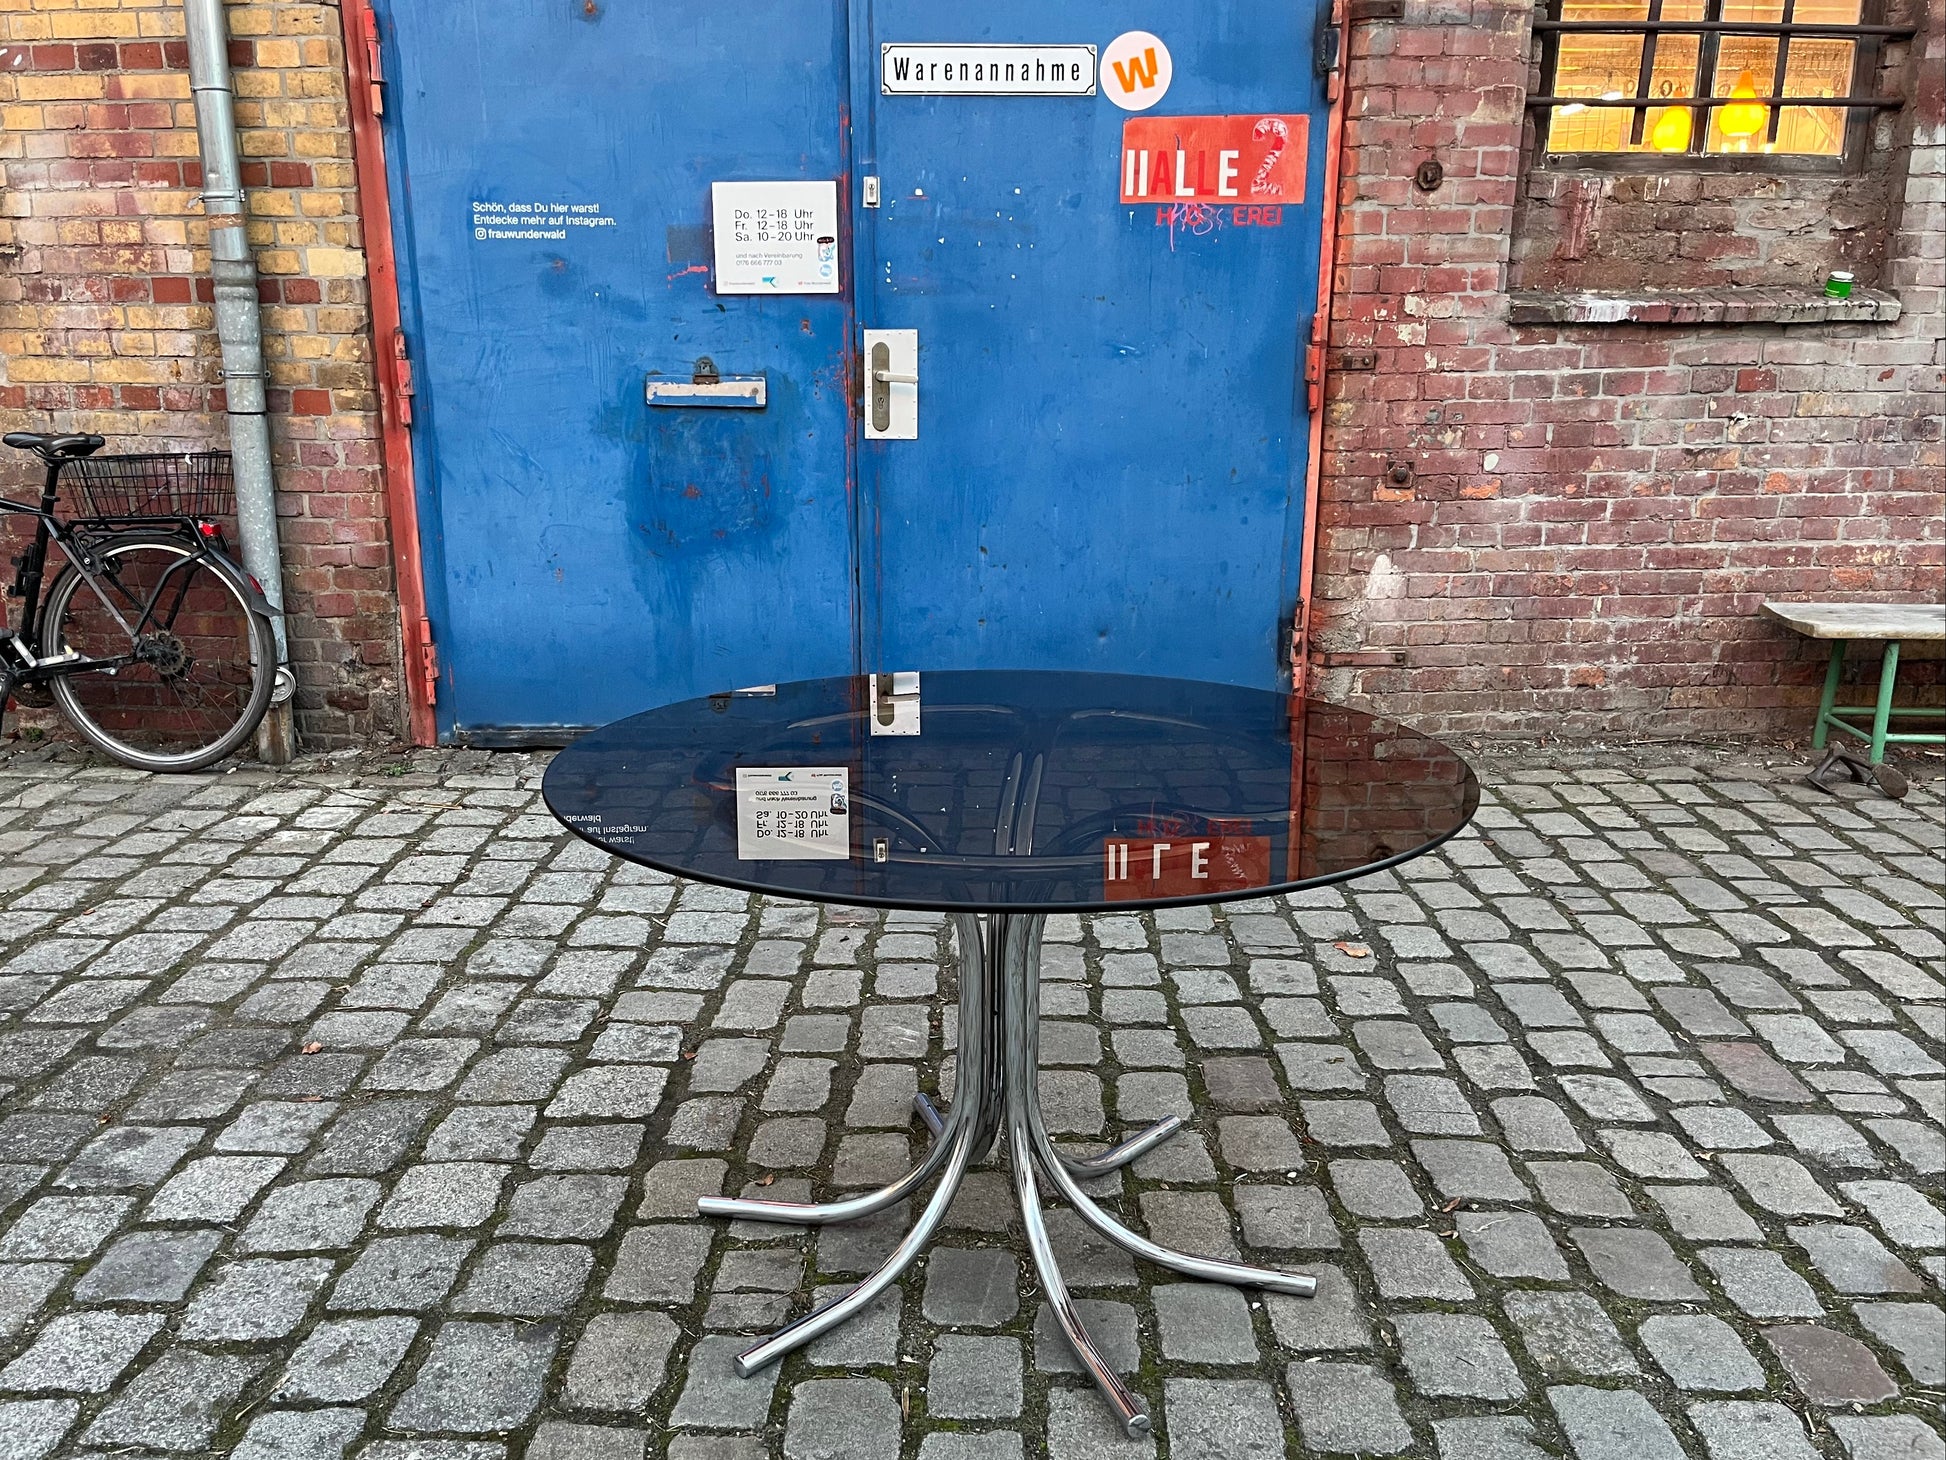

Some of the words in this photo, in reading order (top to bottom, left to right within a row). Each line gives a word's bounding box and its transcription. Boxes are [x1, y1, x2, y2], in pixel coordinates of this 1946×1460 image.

[893, 57, 1080, 82] Warenannahme
[1124, 149, 1239, 197] HALLE
[1251, 118, 1288, 196] 2
[472, 202, 506, 214] Schön,
[508, 203, 532, 212] dass
[534, 202, 548, 212] Du
[550, 203, 568, 212] hier
[571, 203, 600, 213] warst!
[734, 209, 752, 219] Do.
[794, 209, 814, 218] Uhr
[474, 214, 518, 224] Entdecke
[520, 215, 545, 224] mehr
[548, 215, 564, 224] auf
[566, 216, 616, 227] Instagram.
[735, 221, 748, 230] Fr.
[794, 221, 814, 230] Uhr
[488, 229, 566, 240] frauwunderwald
[735, 232, 752, 242] Sa.
[795, 232, 814, 241] Uhr
[764, 252, 803, 260] Vereinbarung
